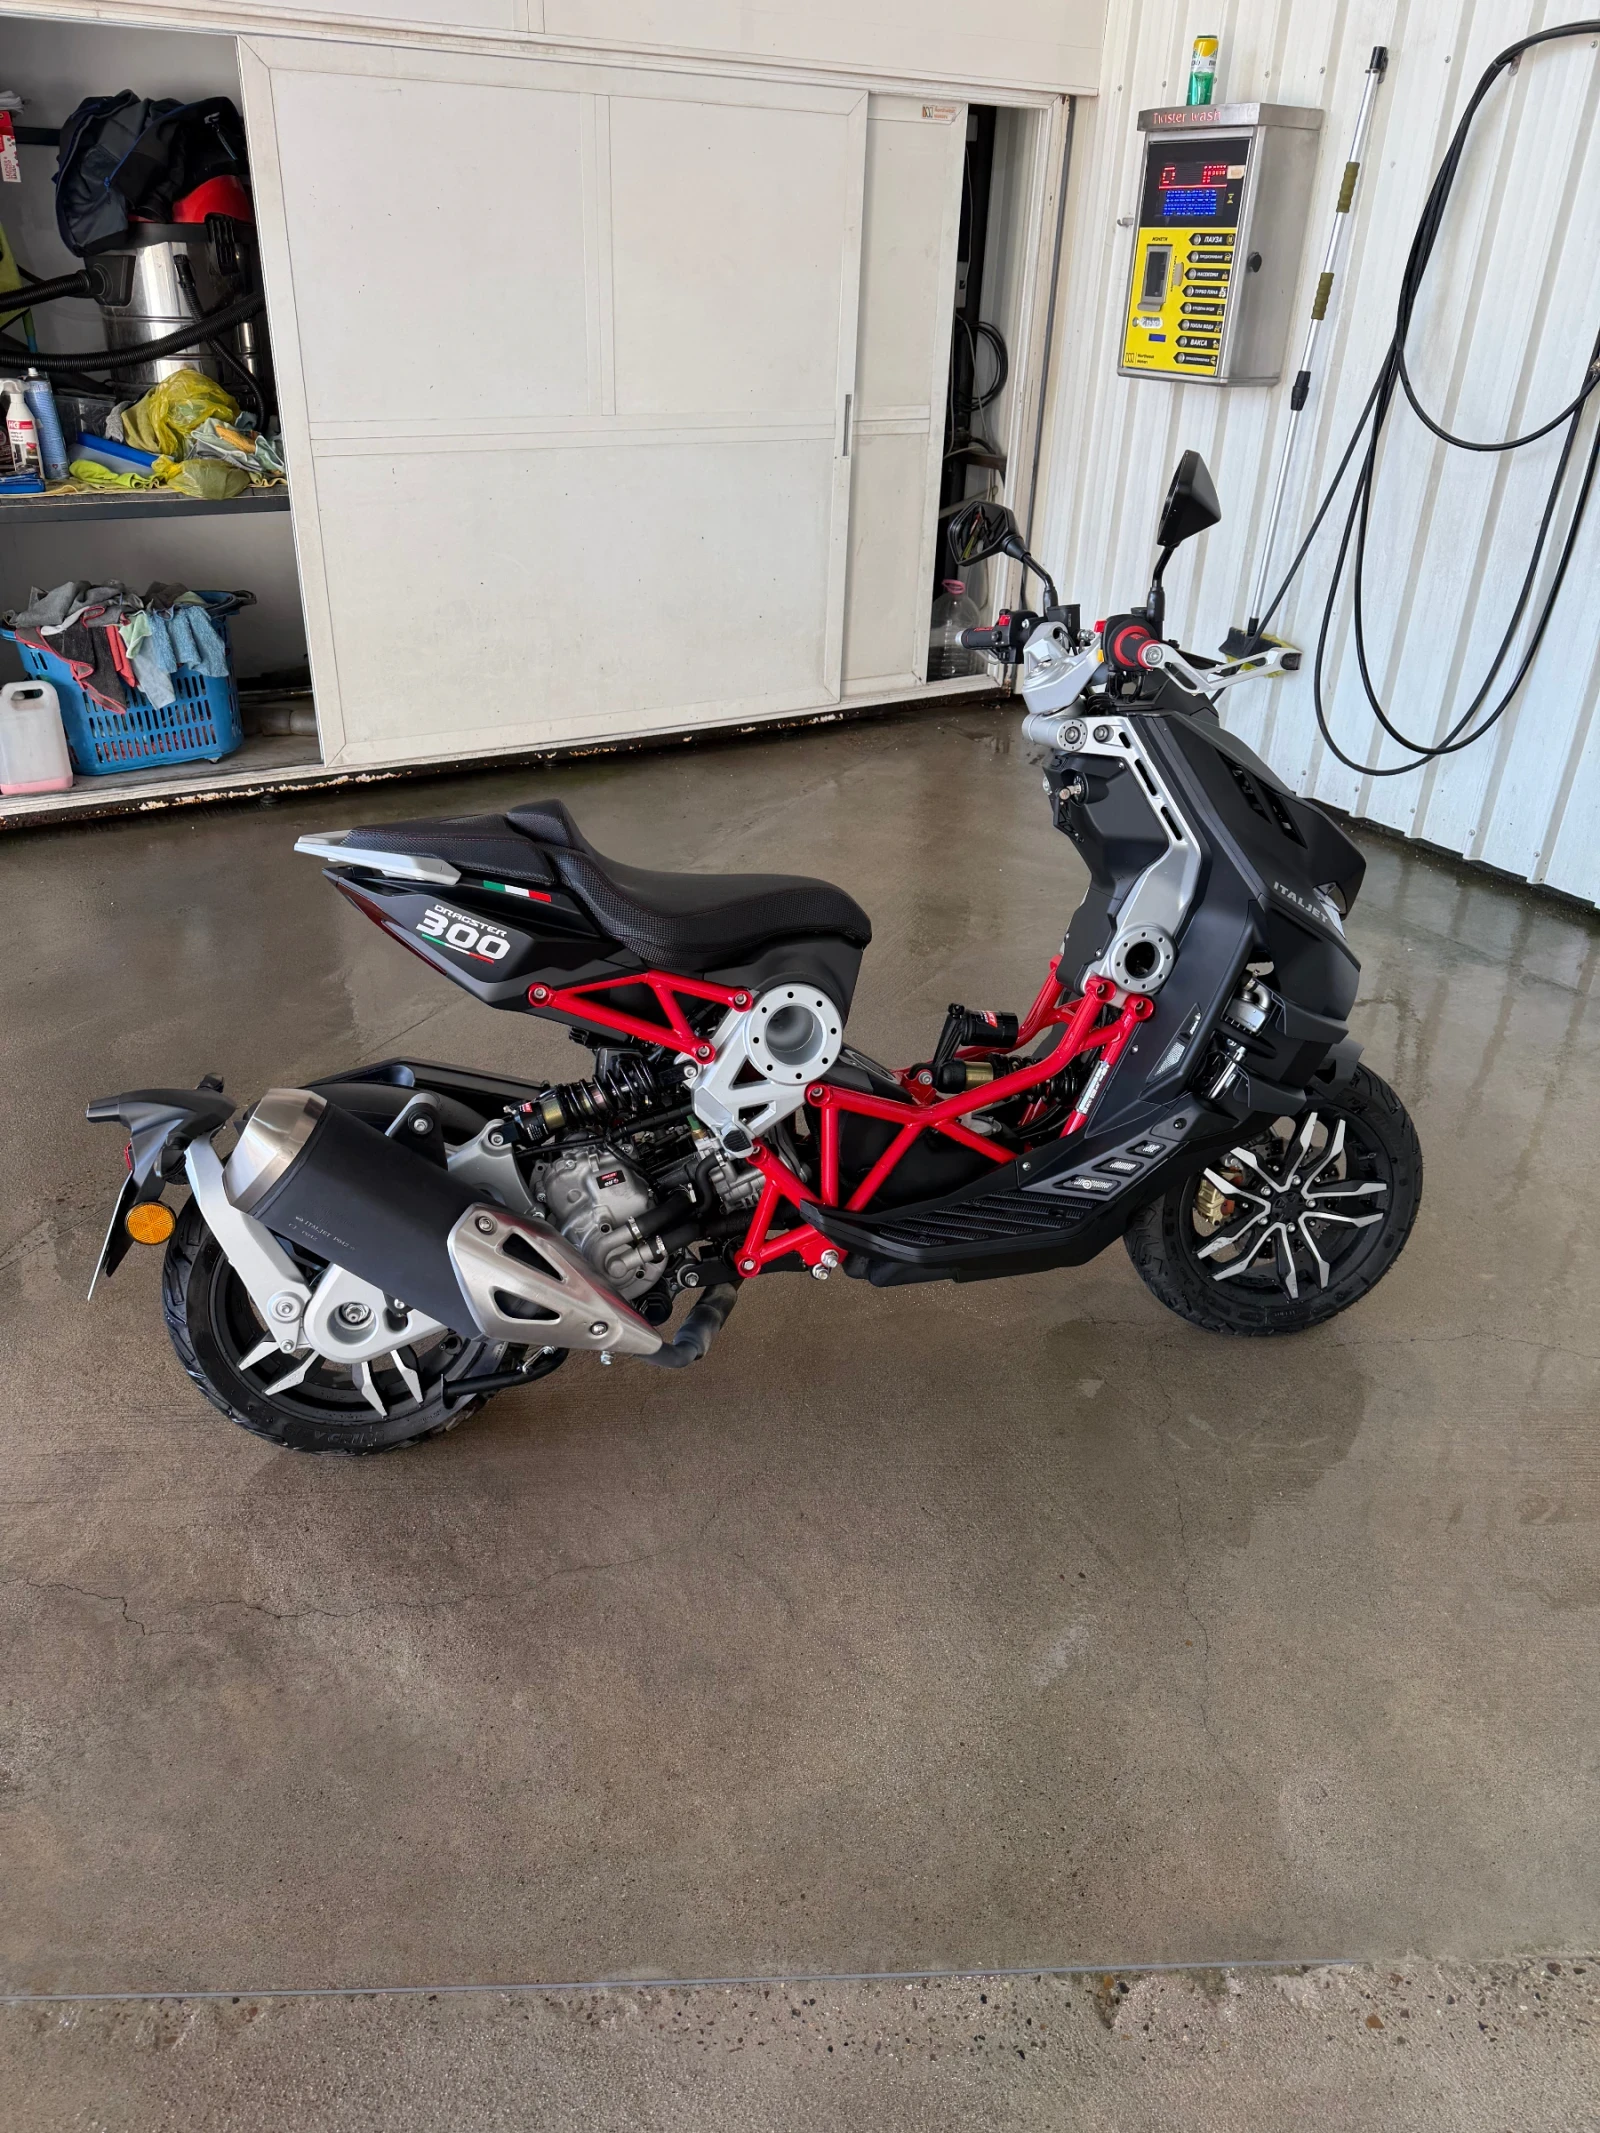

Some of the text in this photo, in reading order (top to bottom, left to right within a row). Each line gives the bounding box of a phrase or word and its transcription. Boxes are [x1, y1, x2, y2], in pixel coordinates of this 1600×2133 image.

[1153, 109, 1221, 124] Twister wash
[1190, 338, 1208, 346] ВАКСА
[8, 421, 20, 429] HG
[1273, 881, 1328, 923] ITALJET
[434, 904, 507, 938] DRAGSTER
[416, 909, 511, 960] 300
[304, 1220, 332, 1237] ITALJET
